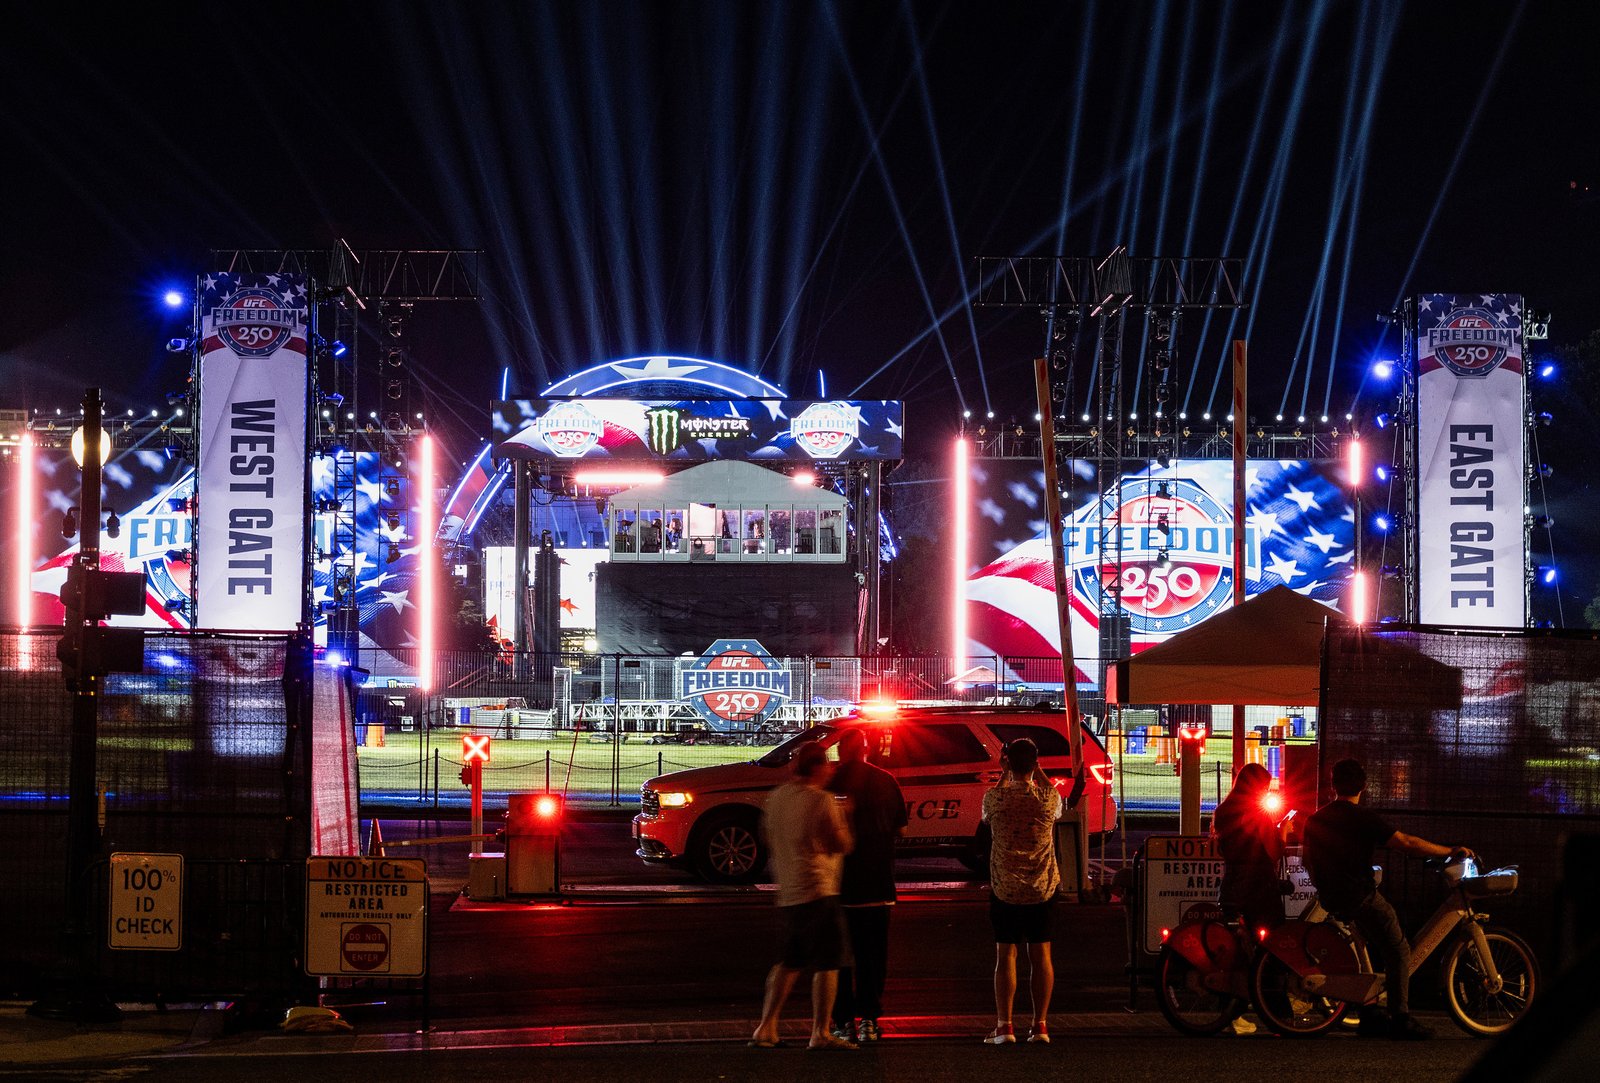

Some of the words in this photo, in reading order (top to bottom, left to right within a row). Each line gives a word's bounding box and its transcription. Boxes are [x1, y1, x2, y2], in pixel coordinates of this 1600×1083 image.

[243, 299, 267, 308] UFC
[213, 309, 298, 328] FREEDOM
[1459, 319, 1482, 328] UFC
[238, 326, 273, 345] 250
[1429, 329, 1514, 348] FREEDOM
[1454, 346, 1489, 365] 250
[680, 418, 750, 431] MONSTER
[557, 431, 585, 447] 250
[811, 432, 839, 448] 250
[229, 399, 276, 498] WEST
[1449, 424, 1494, 511] EAST
[227, 508, 274, 595] GATE
[1450, 521, 1495, 608] GATE
[1120, 566, 1201, 609] 250
[721, 656, 752, 668] UFC
[683, 671, 791, 697] FREEDOM
[715, 693, 760, 717] 250
[906, 800, 961, 820] ICE
[1166, 840, 1223, 857] NOTI
[328, 861, 405, 878] NOTICE
[1164, 862, 1224, 874] RESTRIC
[325, 883, 408, 896] RESTRICTED
[136, 897, 155, 912] ID
[349, 898, 384, 910] AREA
[116, 918, 174, 934] CHECK
[352, 953, 379, 961] ENTER
